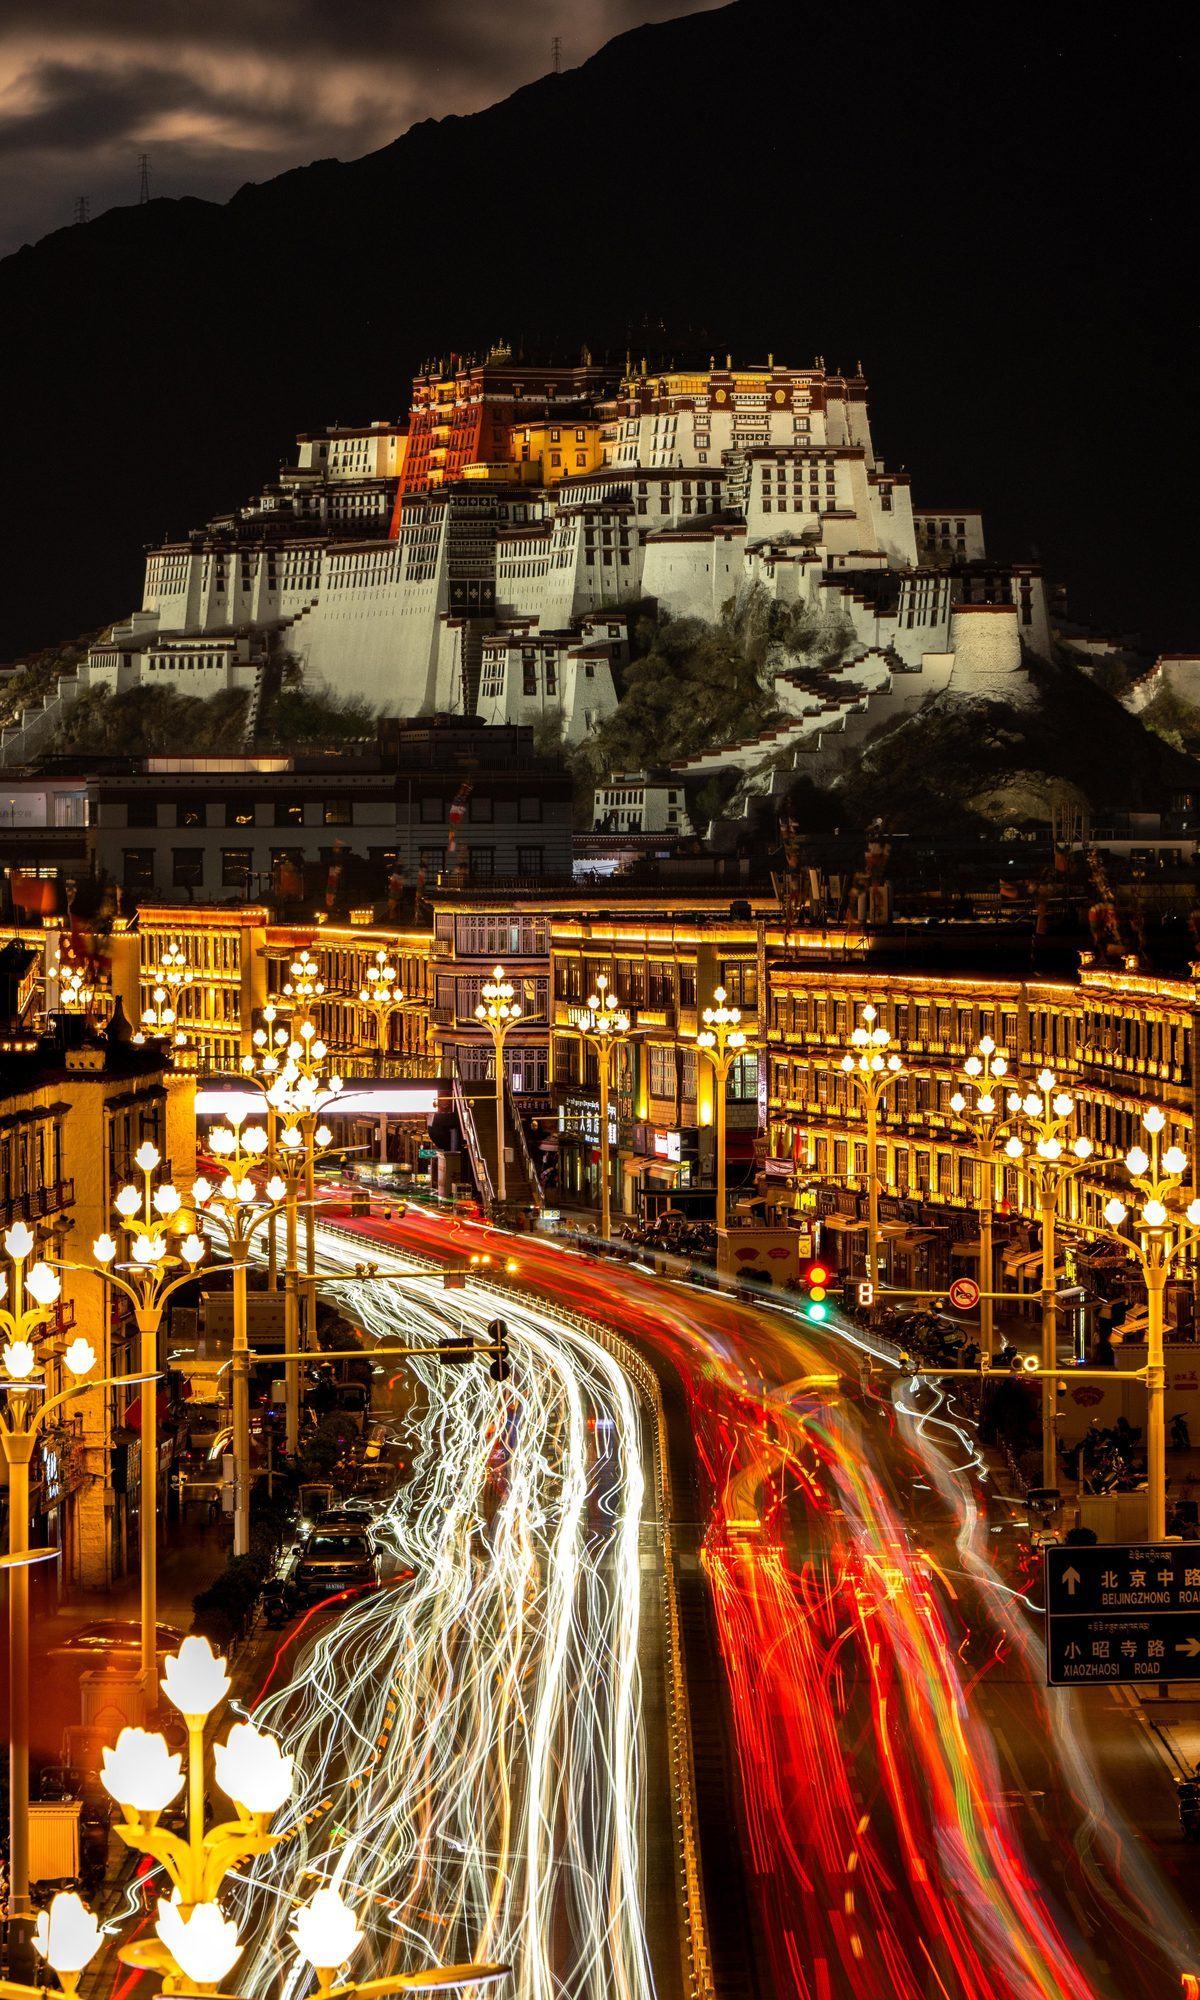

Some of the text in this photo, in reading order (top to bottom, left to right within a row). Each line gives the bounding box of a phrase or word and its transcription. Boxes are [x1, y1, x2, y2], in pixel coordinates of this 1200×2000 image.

[859, 1283, 873, 1305] 8
[1101, 1568, 1200, 1588] 北京中路
[1102, 1590, 1200, 1605] BEIJINGZHONG ROA
[1064, 1639, 1165, 1660] 小昭寺路
[1063, 1662, 1160, 1676] XIAOZHAOSI ROAD
